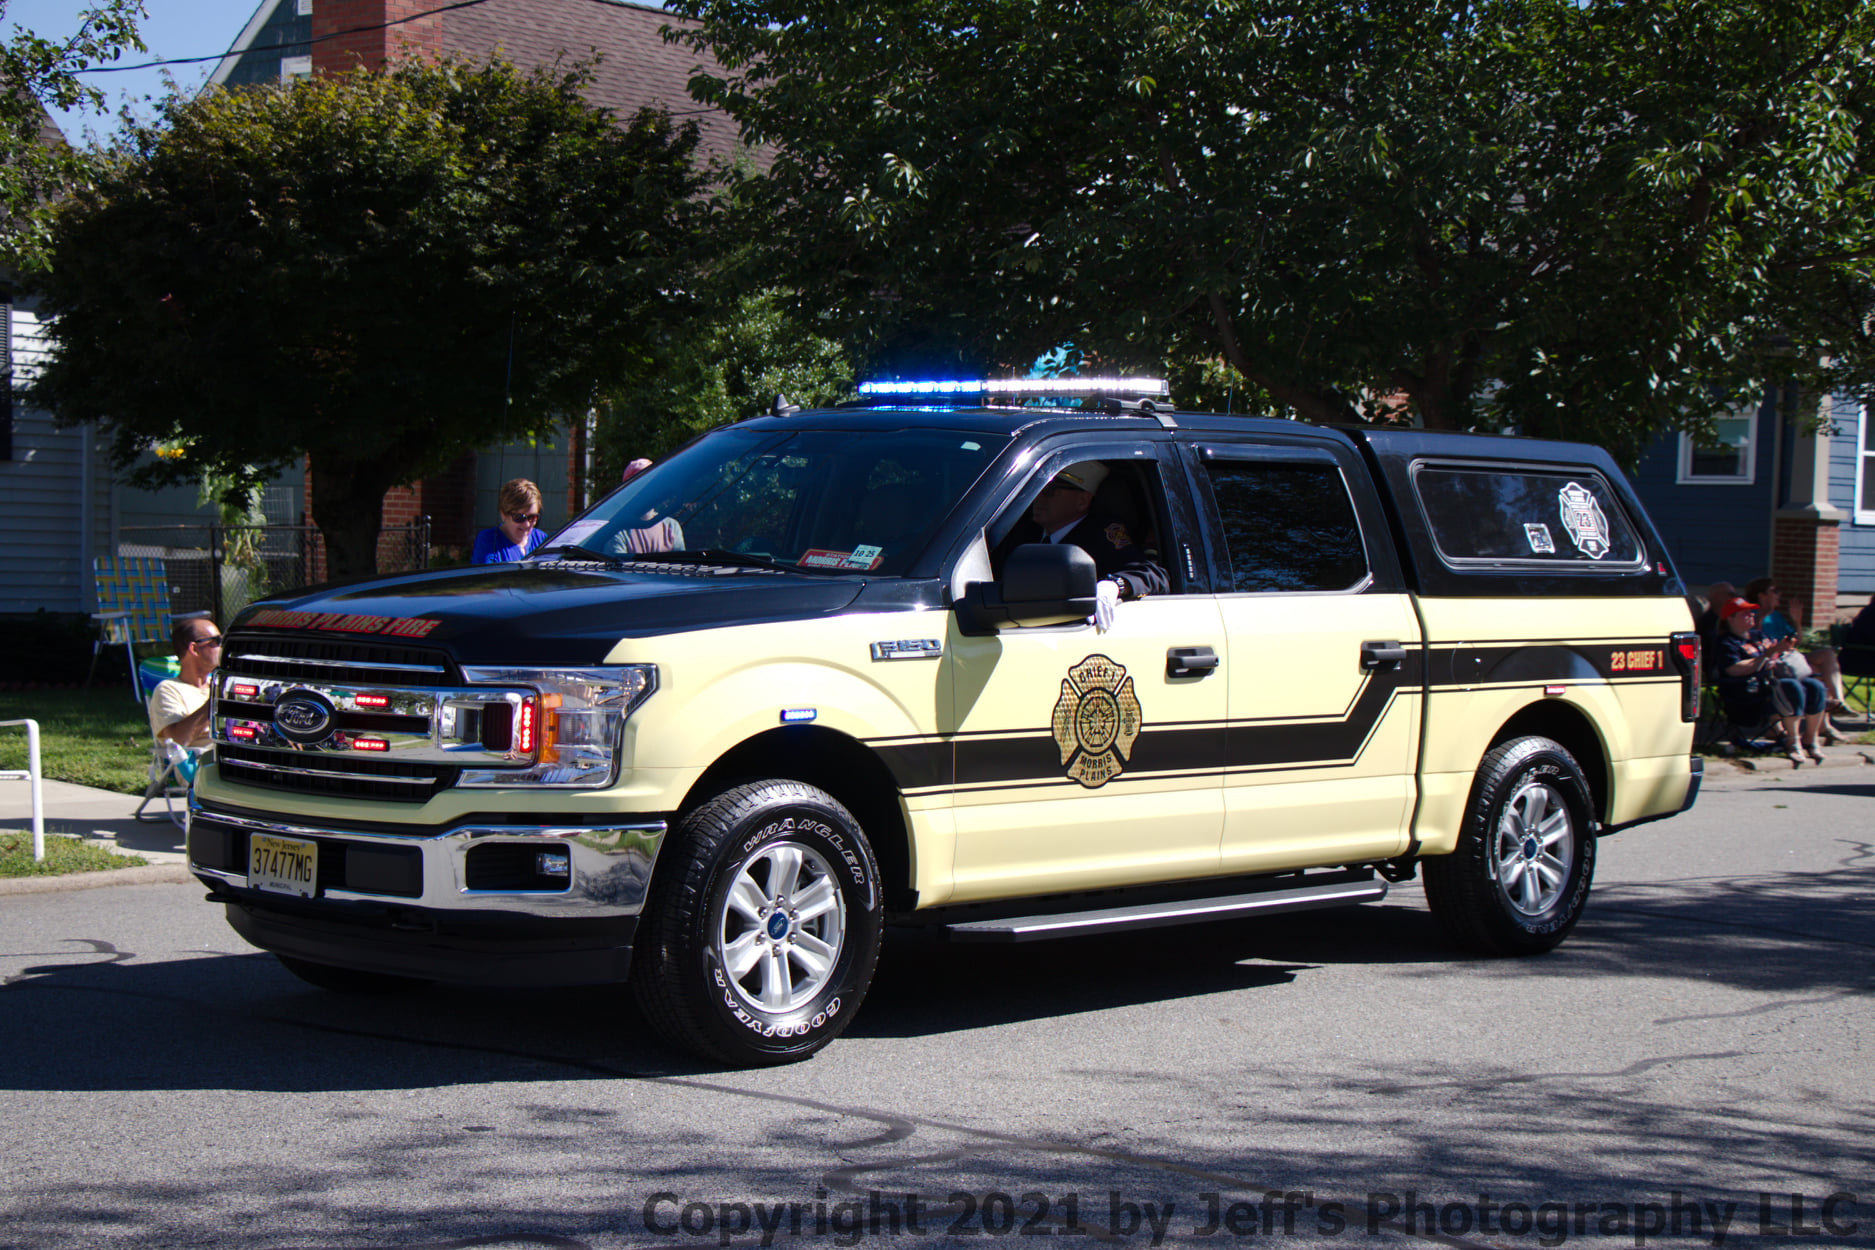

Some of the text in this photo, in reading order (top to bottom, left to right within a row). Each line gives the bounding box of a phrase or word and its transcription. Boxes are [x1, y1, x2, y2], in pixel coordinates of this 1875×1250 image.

[854, 550, 864, 558] 10
[865, 550, 876, 558] 25
[245, 610, 443, 638] MORRIS PLAINS FIRE
[1611, 650, 1664, 671] 23 CHIEF 1
[1078, 665, 1109, 683] CHIEF
[285, 705, 315, 726] Ford
[1079, 753, 1112, 770] MORRIS
[1080, 766, 1113, 781] PLAINS
[743, 817, 865, 885] WRANGLER
[253, 847, 313, 882] 37477MG
[714, 967, 842, 1038] GOODYEAR
